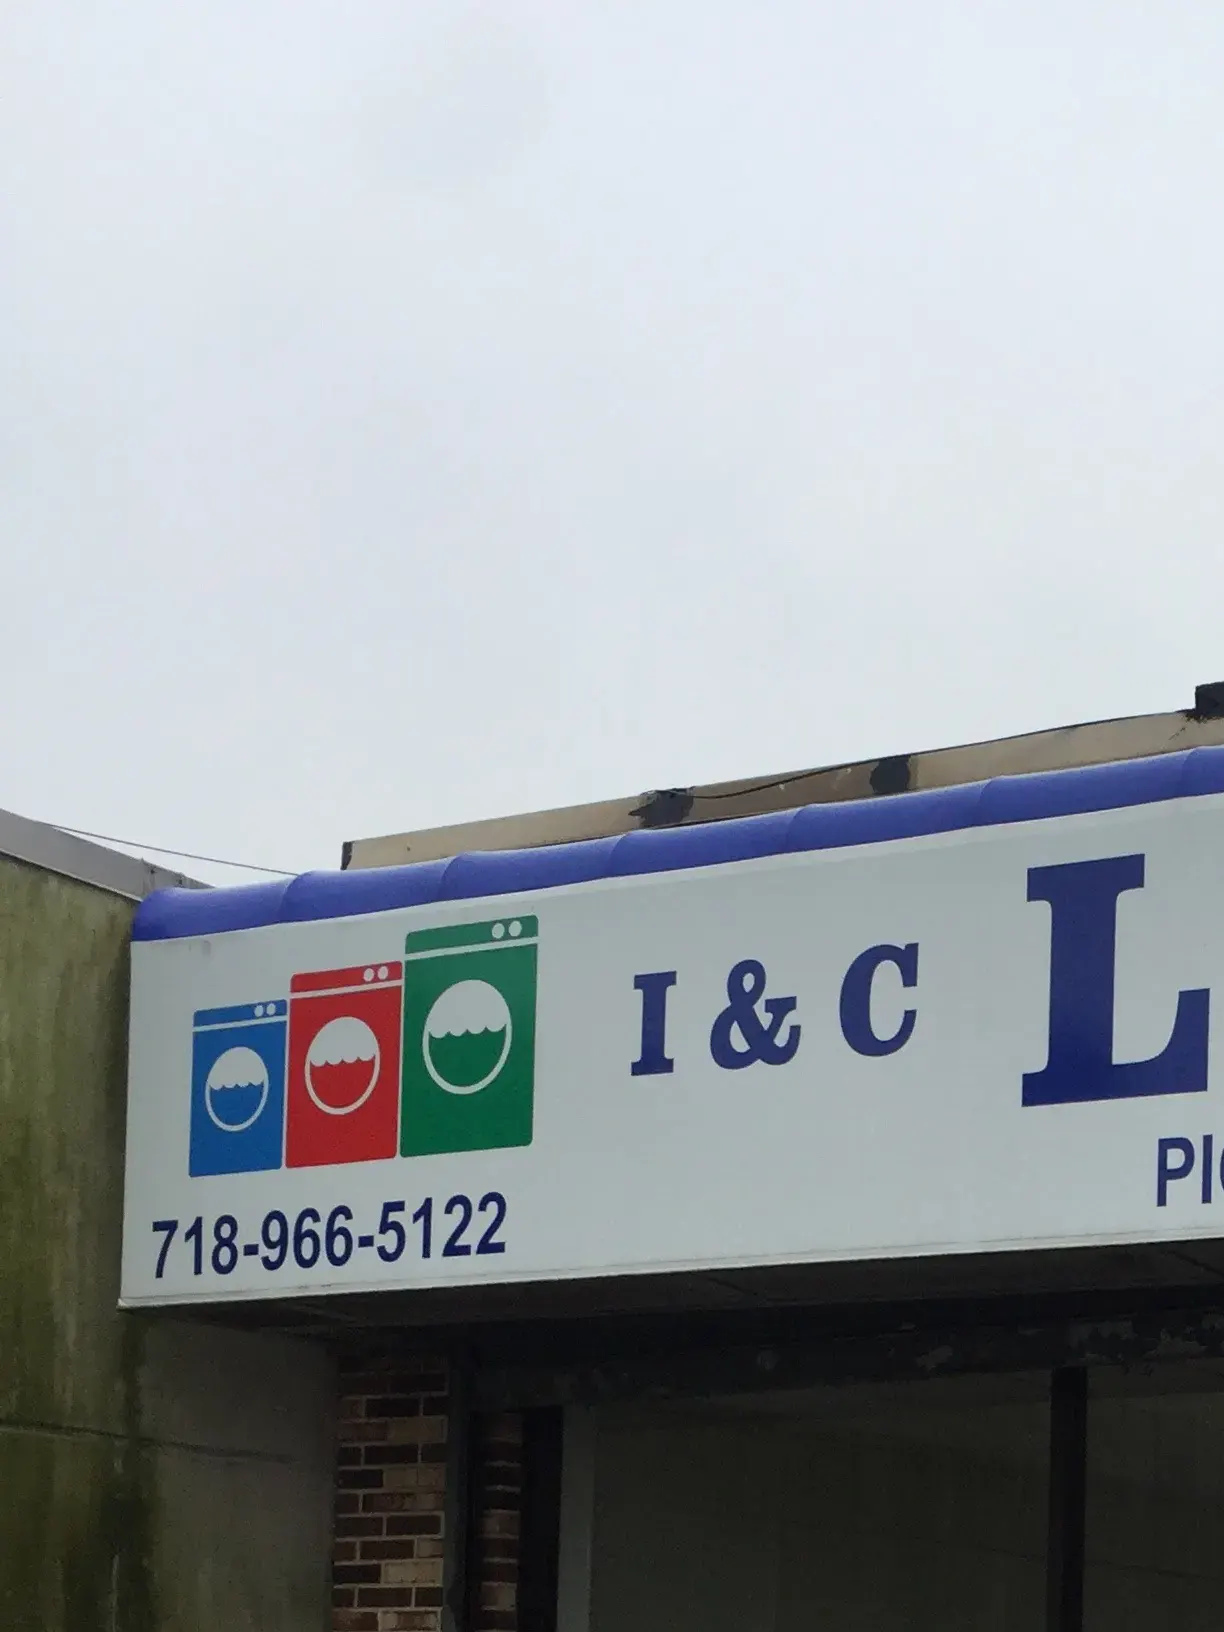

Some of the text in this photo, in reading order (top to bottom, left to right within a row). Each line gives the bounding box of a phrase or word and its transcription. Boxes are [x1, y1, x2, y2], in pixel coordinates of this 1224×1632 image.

[631, 970, 677, 1076] I
[709, 960, 800, 1069] &
[839, 942, 919, 1057] C
[152, 1191, 507, 1278] 718-966-5122
